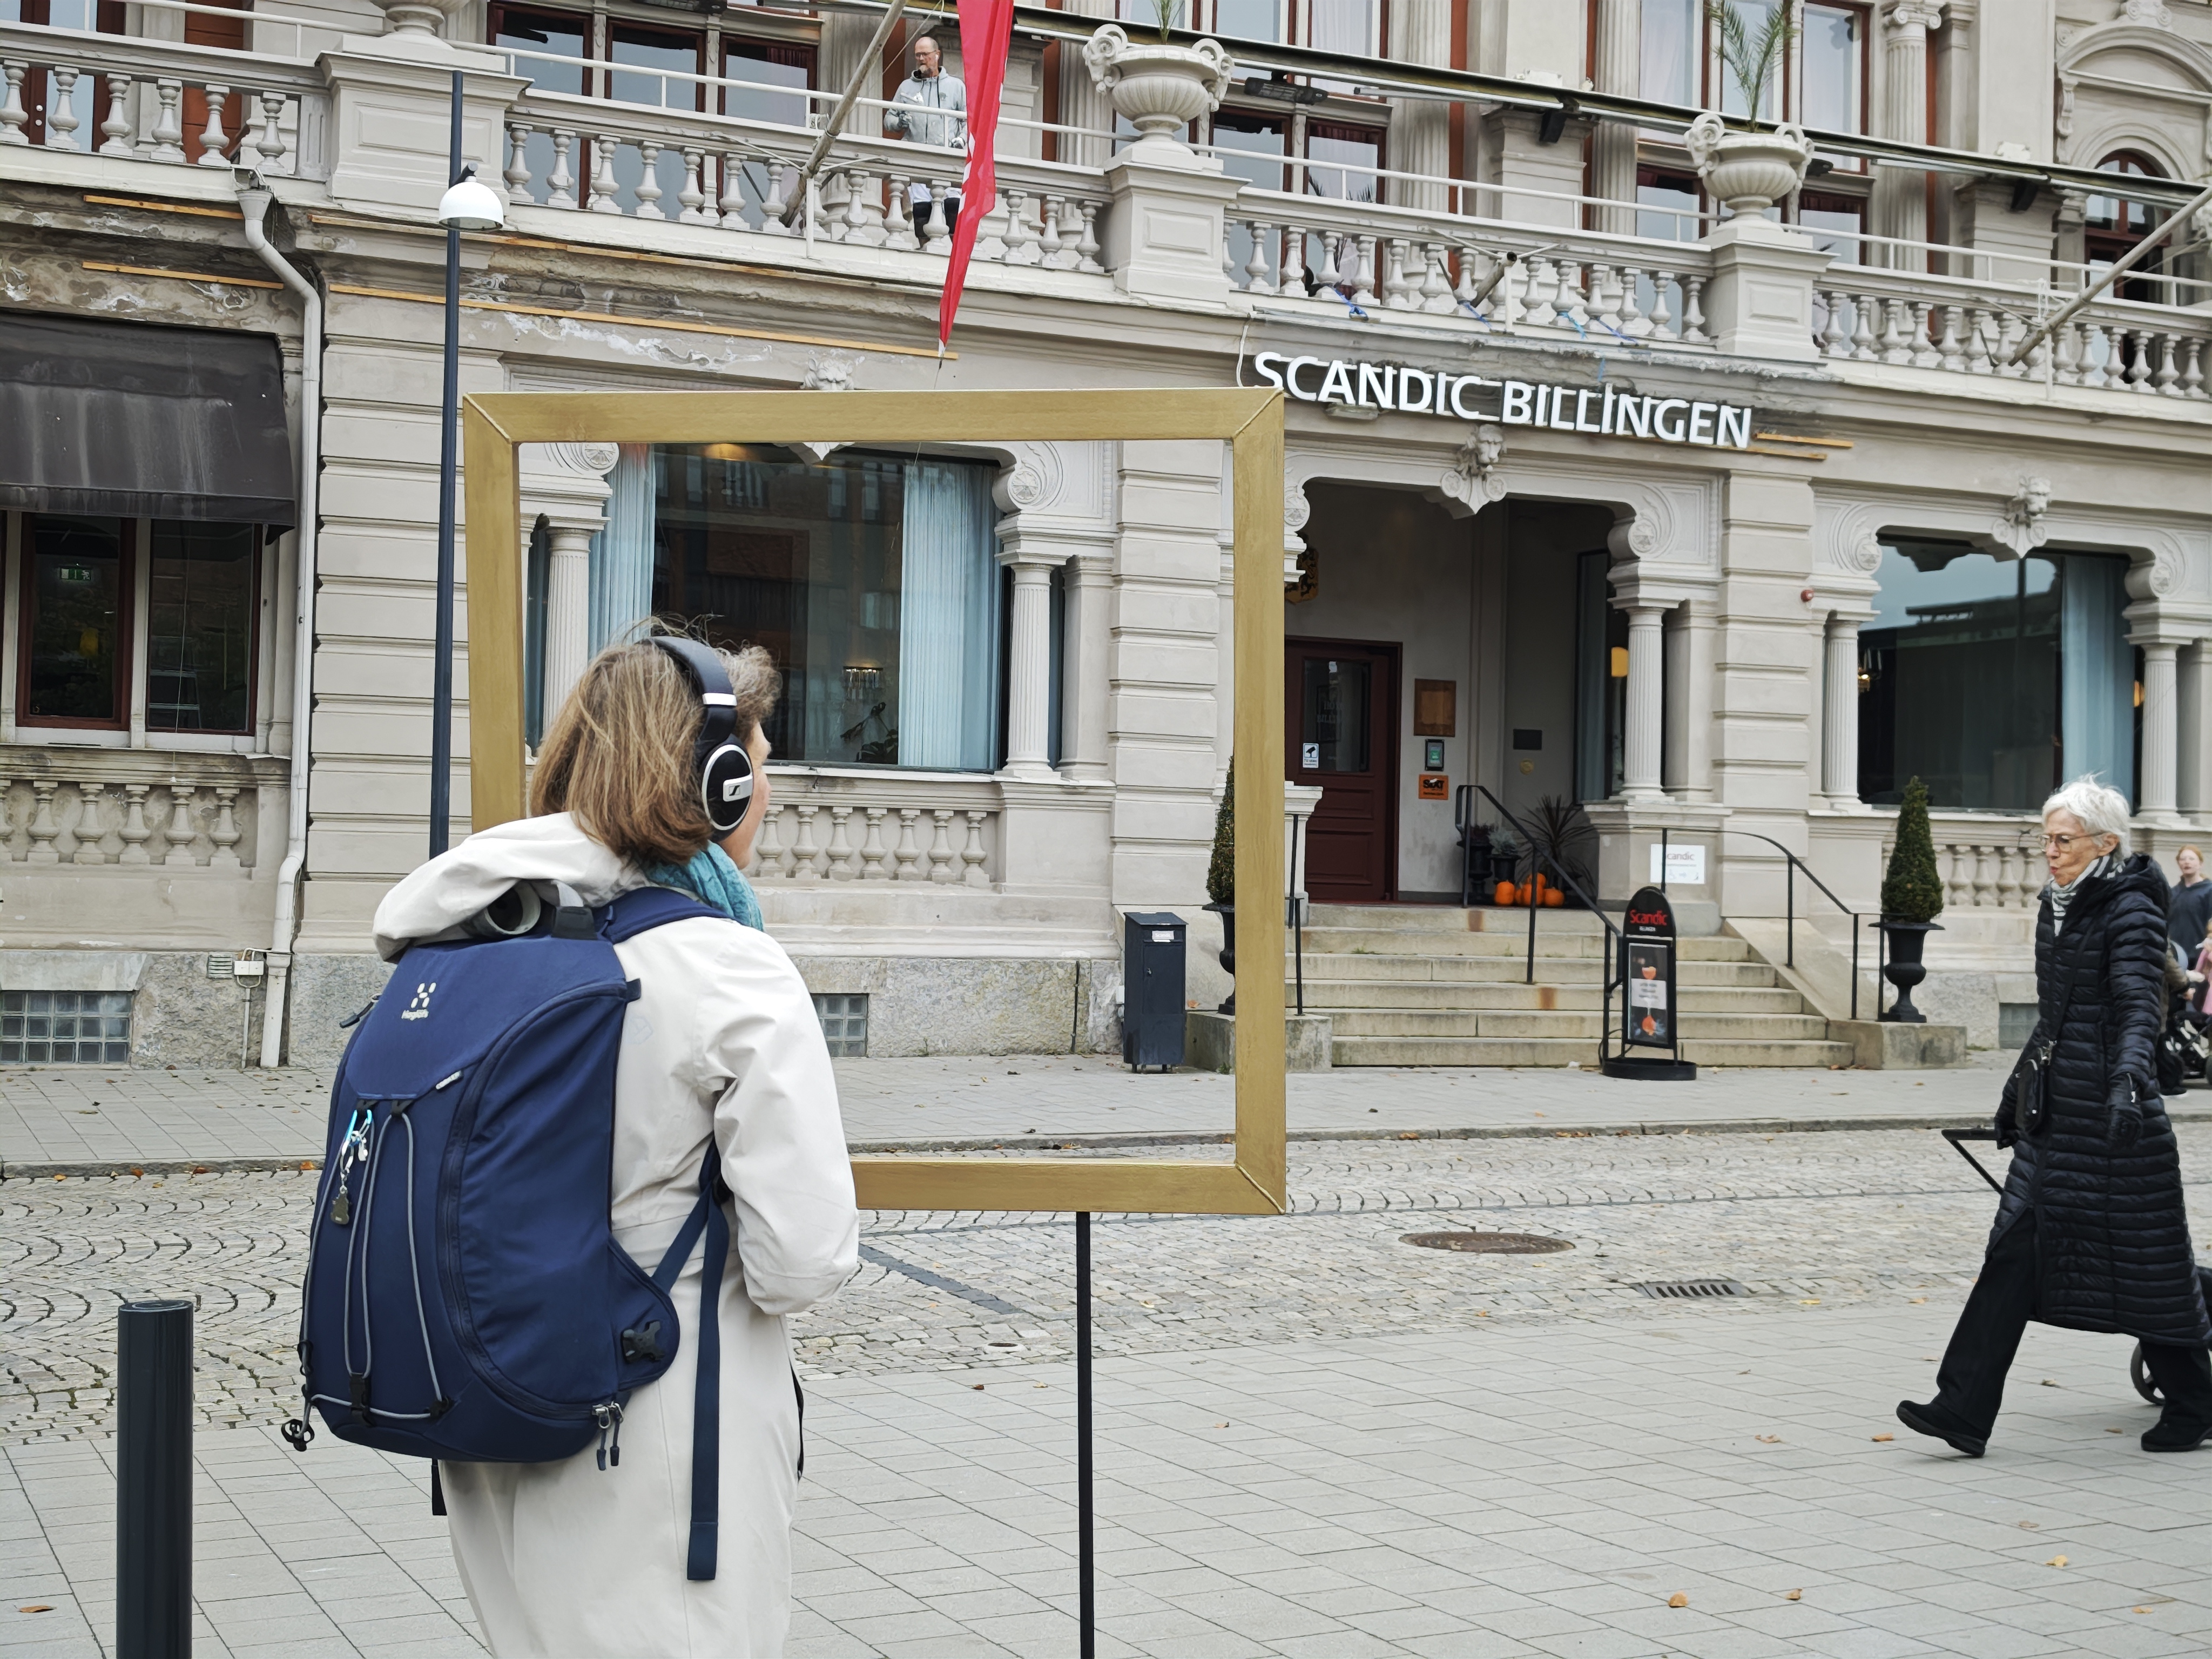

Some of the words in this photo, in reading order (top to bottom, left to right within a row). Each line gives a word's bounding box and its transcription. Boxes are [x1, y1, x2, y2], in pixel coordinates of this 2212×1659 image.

[1255, 351, 1481, 420] SCANDIC
[1502, 380, 1752, 449] BILLINGEN
[1666, 851, 1695, 860] candic
[1630, 909, 1668, 926] Scandic
